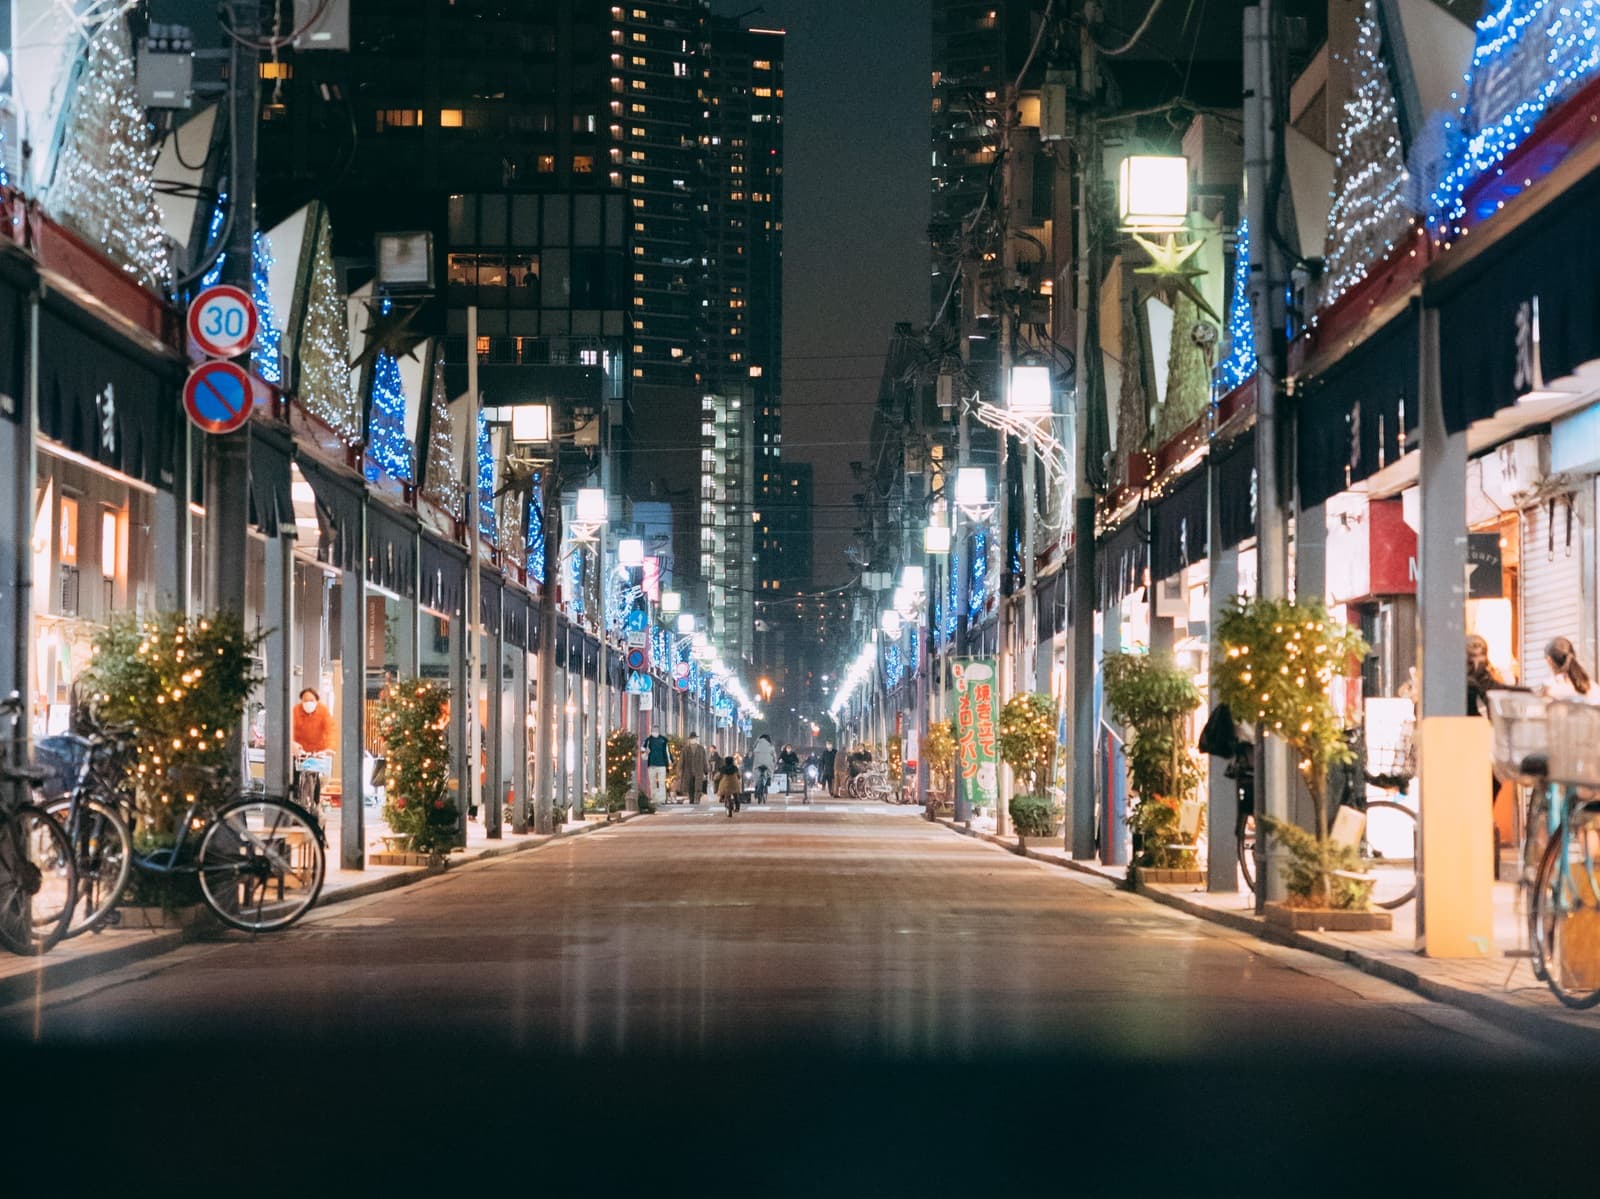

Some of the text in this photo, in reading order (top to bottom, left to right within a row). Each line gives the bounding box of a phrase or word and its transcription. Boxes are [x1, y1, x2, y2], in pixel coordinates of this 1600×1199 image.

[205, 306, 243, 337] 30
[960, 692, 977, 779] メロンパン
[974, 684, 995, 757] 焼き立て
